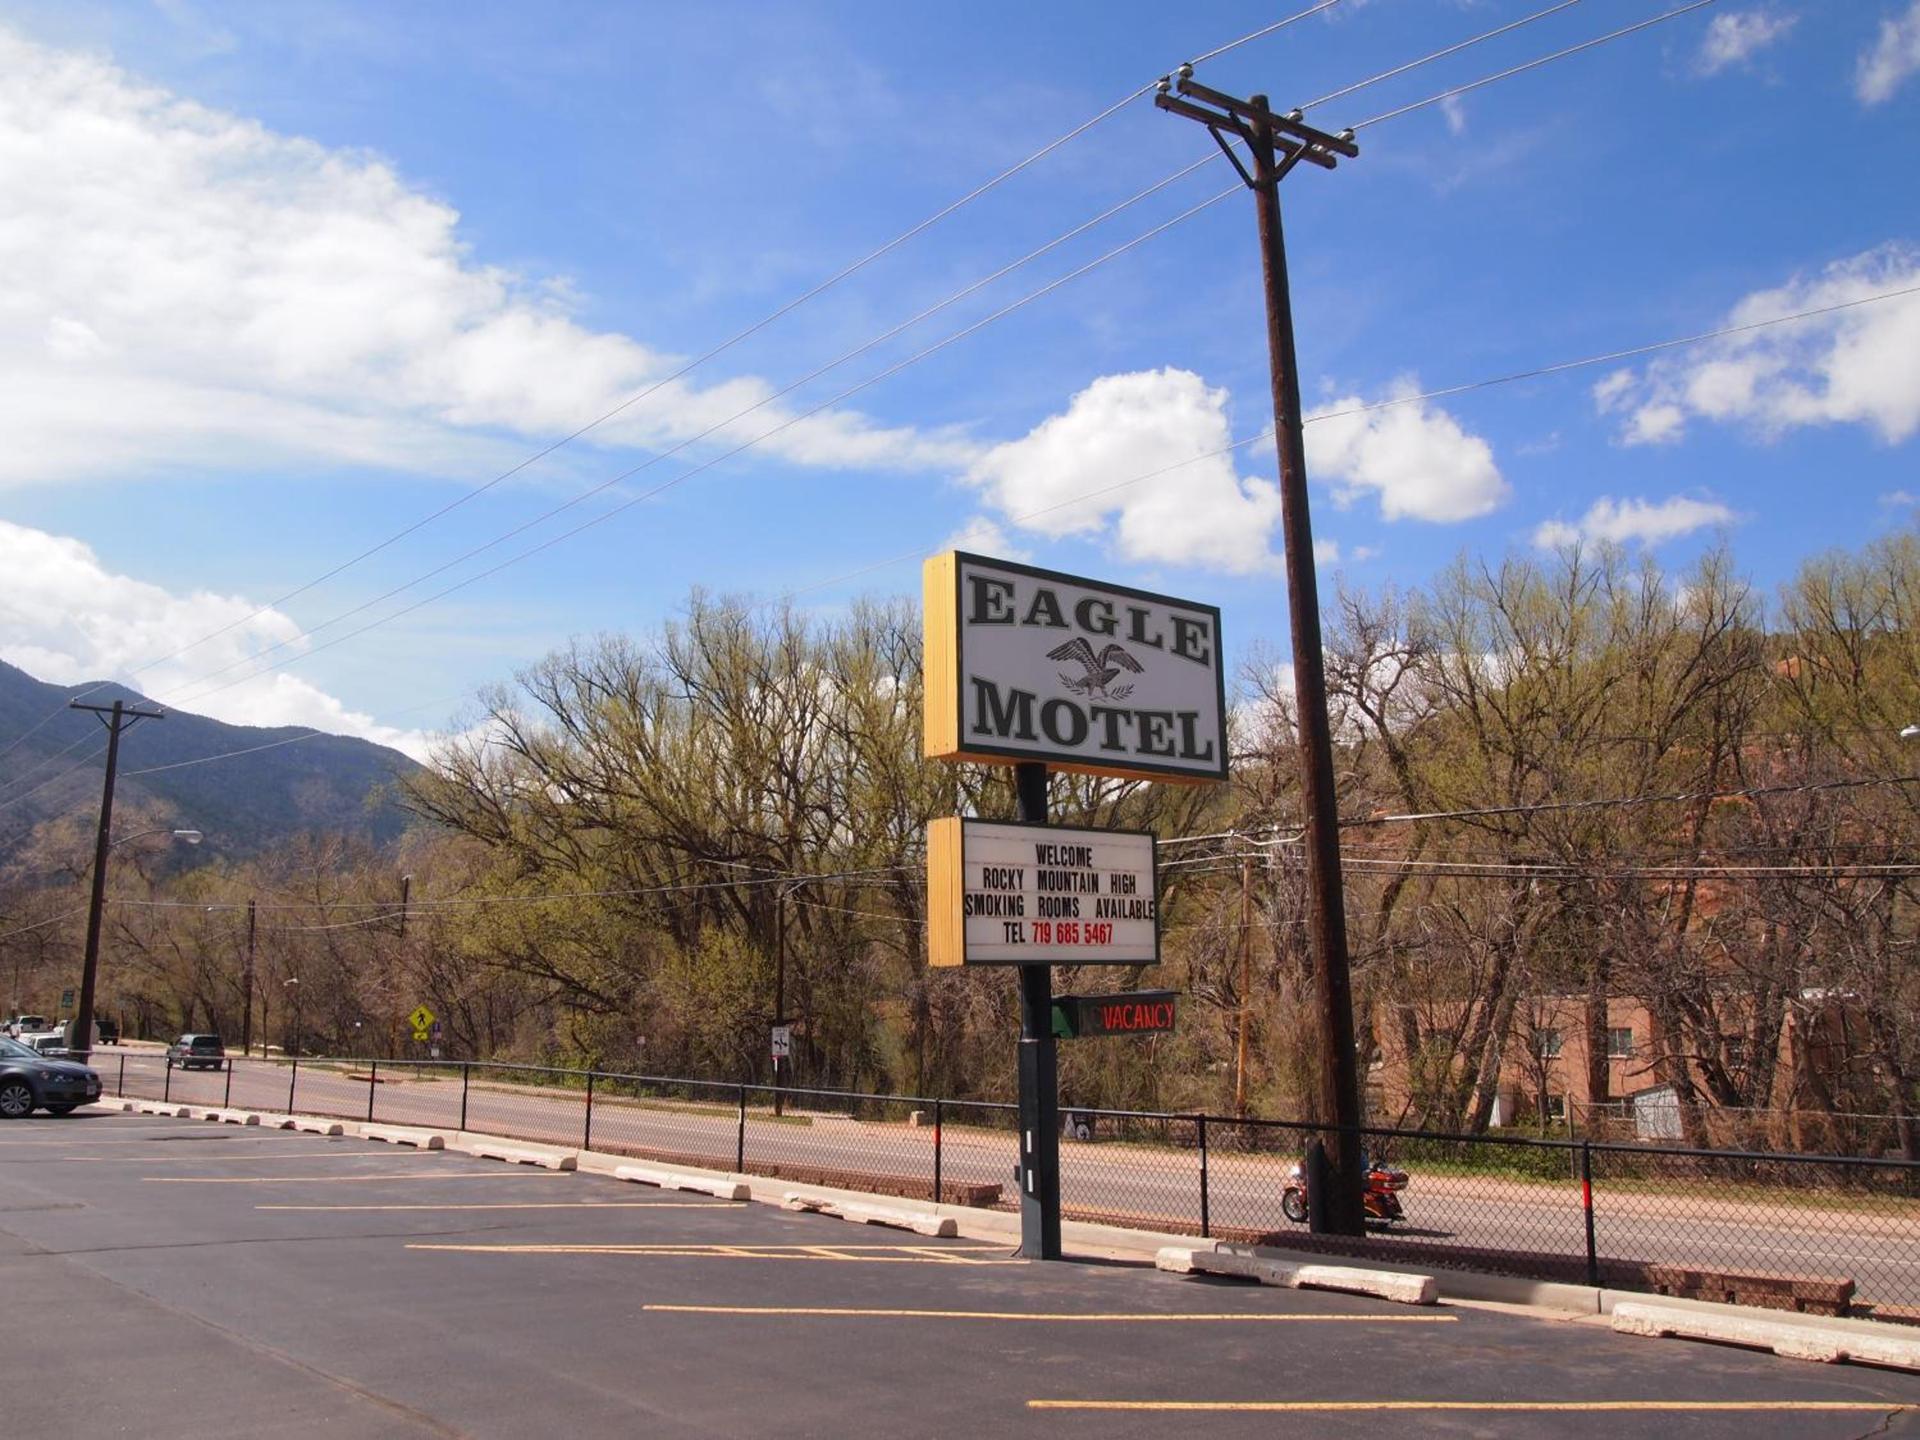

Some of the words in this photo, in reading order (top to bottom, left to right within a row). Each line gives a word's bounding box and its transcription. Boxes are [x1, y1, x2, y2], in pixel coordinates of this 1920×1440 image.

[968, 573, 1210, 667] EAGLE
[971, 676, 1213, 762] MOTEL
[1035, 843, 1093, 868] WELCOME
[983, 867, 1024, 890] ROCKY
[1037, 870, 1099, 893] MOUNTAIN
[1110, 874, 1136, 894] HIGH
[965, 894, 1024, 916] SMOKING
[1038, 896, 1080, 918] ROOMS
[1095, 898, 1154, 920] AVAILABLE
[1003, 921, 1026, 944] TEL
[1032, 922, 1052, 944] 719
[1056, 922, 1080, 944] 685
[1084, 922, 1113, 945] 5467
[1103, 1001, 1174, 1030] VACANCY
